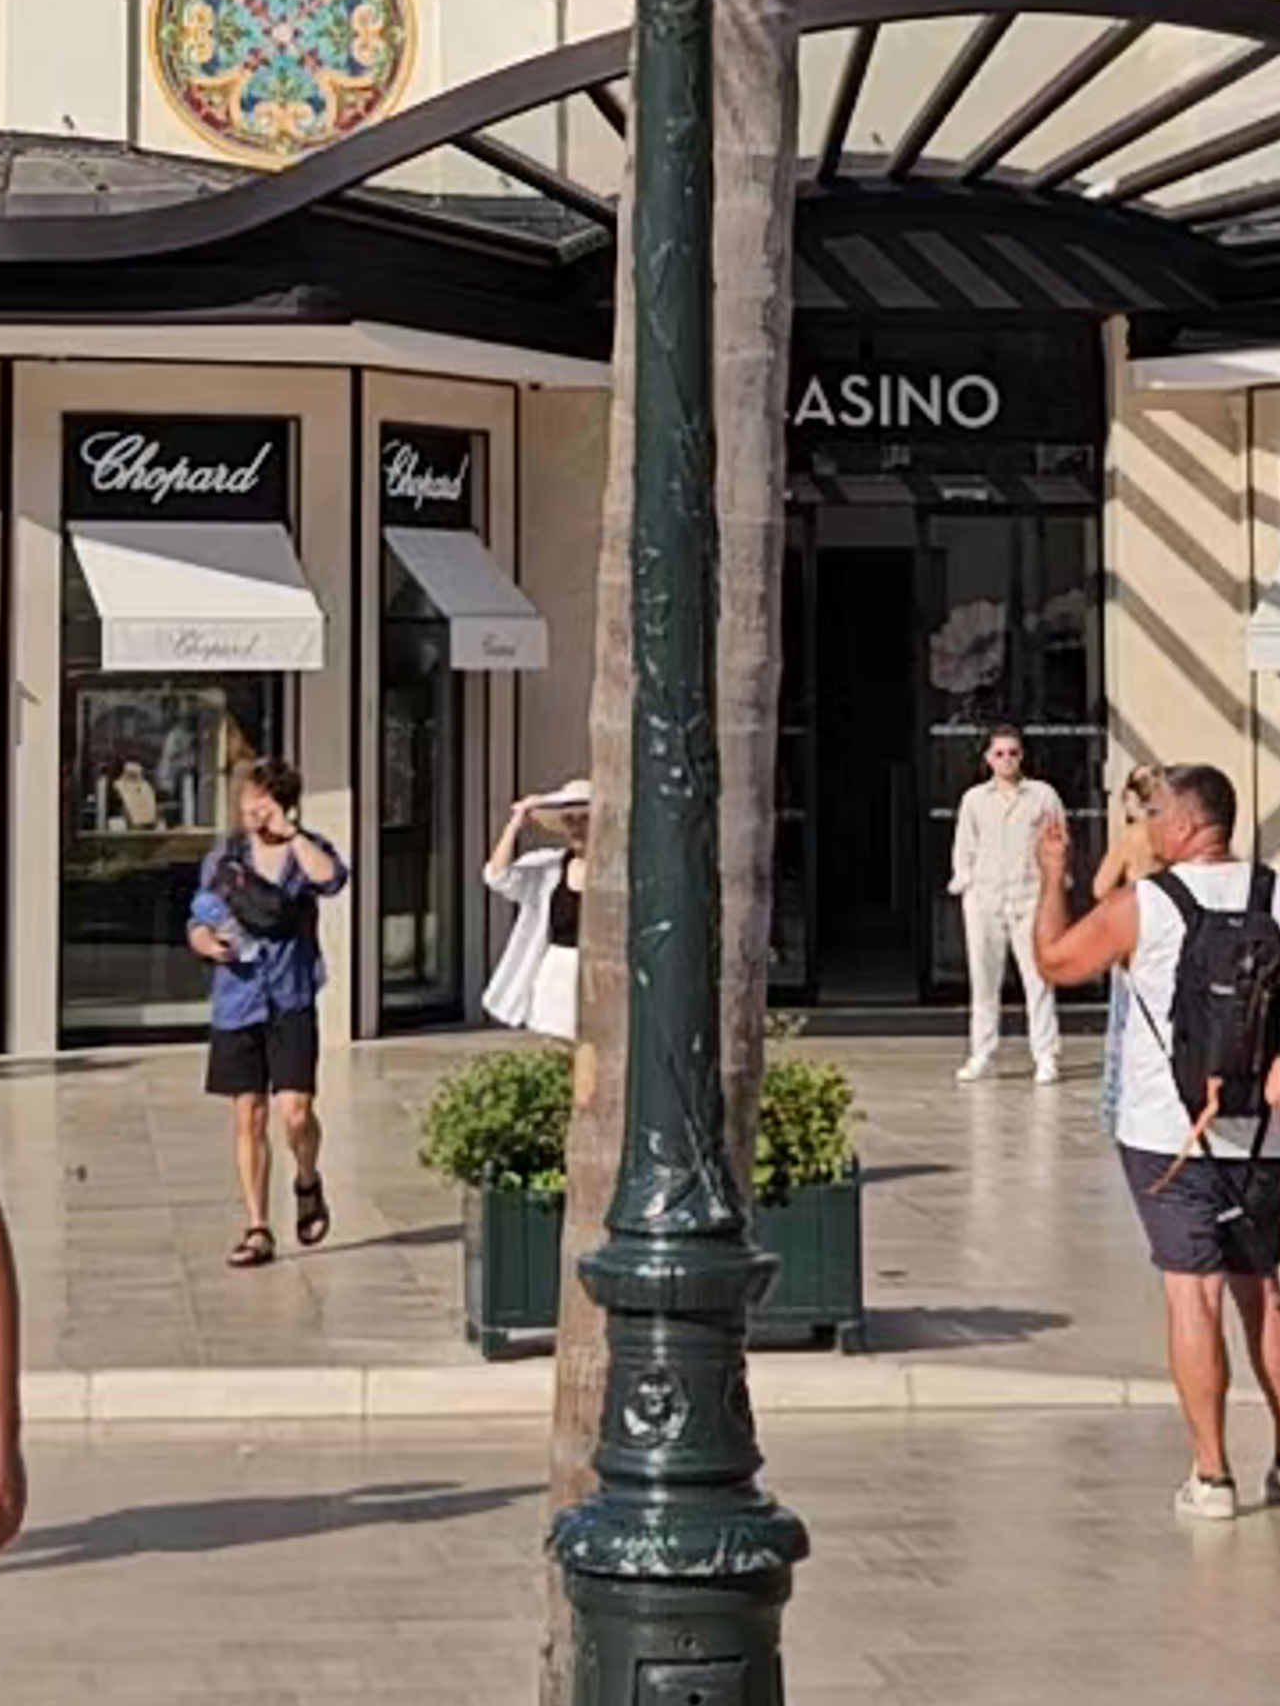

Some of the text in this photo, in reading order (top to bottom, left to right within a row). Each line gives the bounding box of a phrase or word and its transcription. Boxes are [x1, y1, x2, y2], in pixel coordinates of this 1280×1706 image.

[785, 373, 1000, 430] ASINO
[80, 431, 272, 505] Chopard
[382, 439, 470, 512] Chopard
